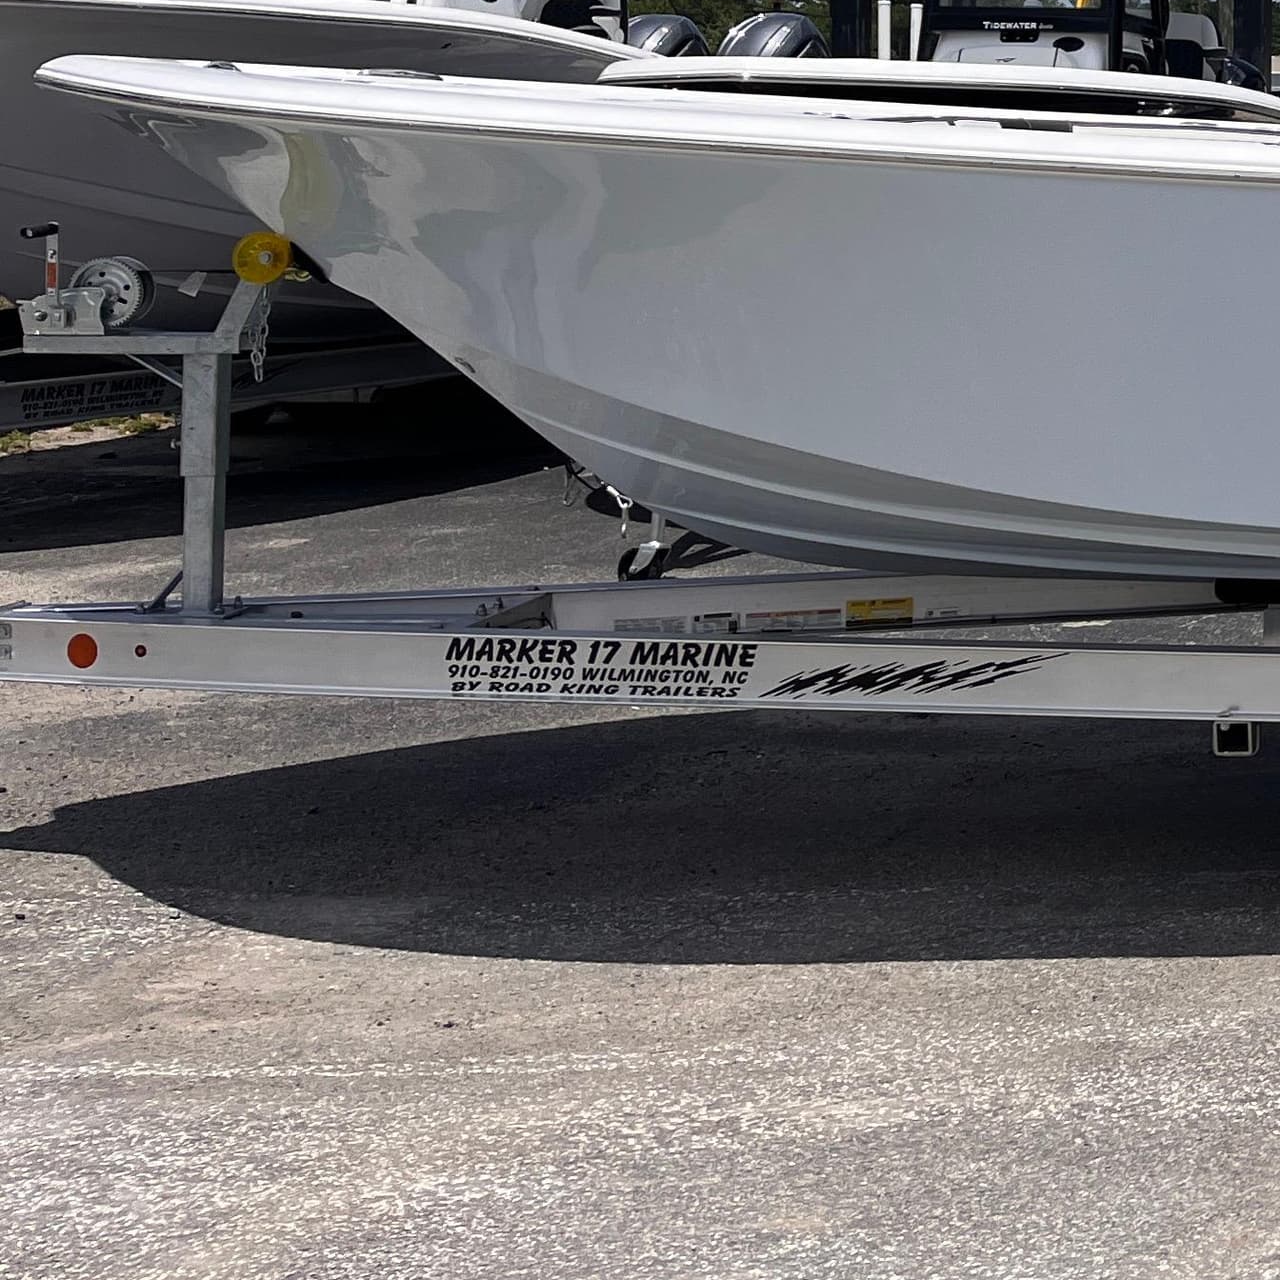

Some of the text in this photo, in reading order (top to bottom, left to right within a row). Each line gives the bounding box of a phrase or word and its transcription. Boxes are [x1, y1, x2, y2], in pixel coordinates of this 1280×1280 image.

[982, 21, 1038, 30] TIDEWATER
[20, 383, 85, 403] MARKER
[90, 381, 107, 396] 17
[445, 637, 758, 668] MARKER 17 MARINE
[448, 664, 749, 685] 910-821-0190 WILMINGTON, NC
[450, 681, 741, 698] BY ROAD KING TRAILERS
